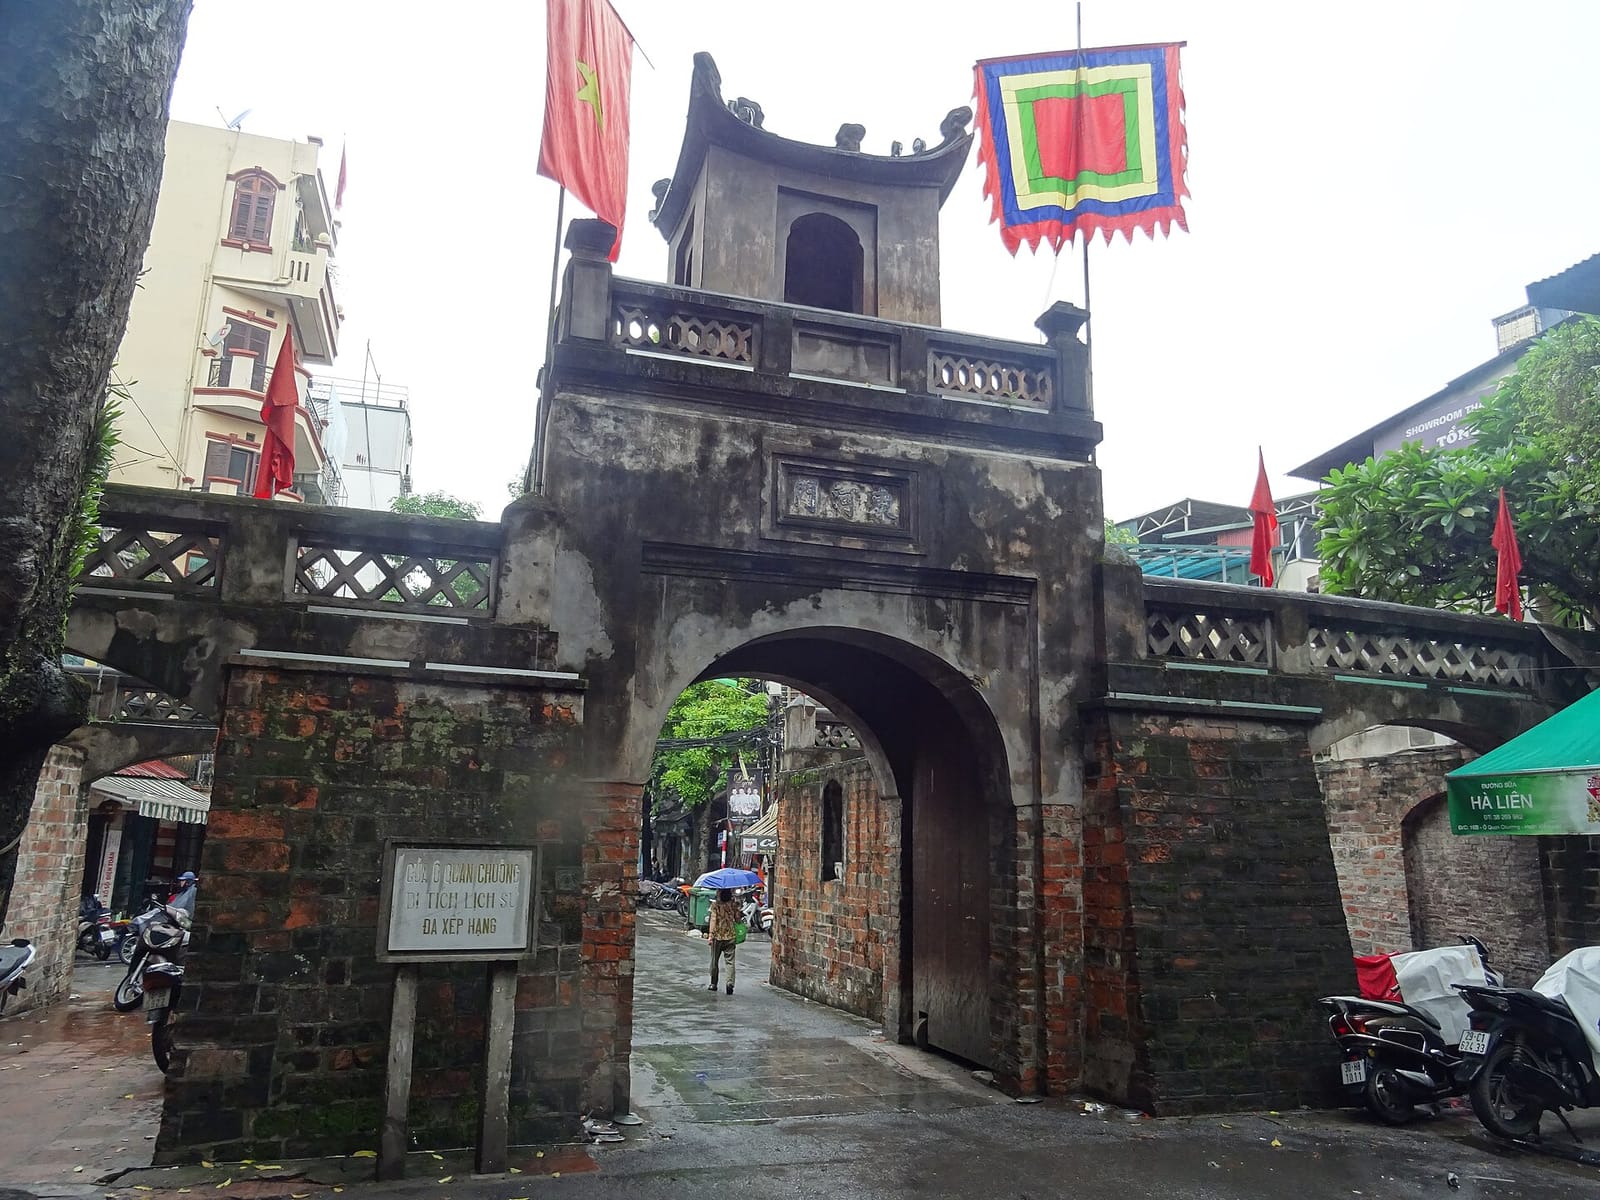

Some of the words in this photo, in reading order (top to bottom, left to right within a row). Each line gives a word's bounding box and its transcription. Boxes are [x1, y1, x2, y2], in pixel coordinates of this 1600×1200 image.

[1405, 408, 1463, 438] SHOWROOM
[1470, 792, 1493, 809] HÀ
[1496, 791, 1533, 809] LIÊN
[444, 863, 473, 884] QUAN
[467, 917, 497, 937] HẠNG
